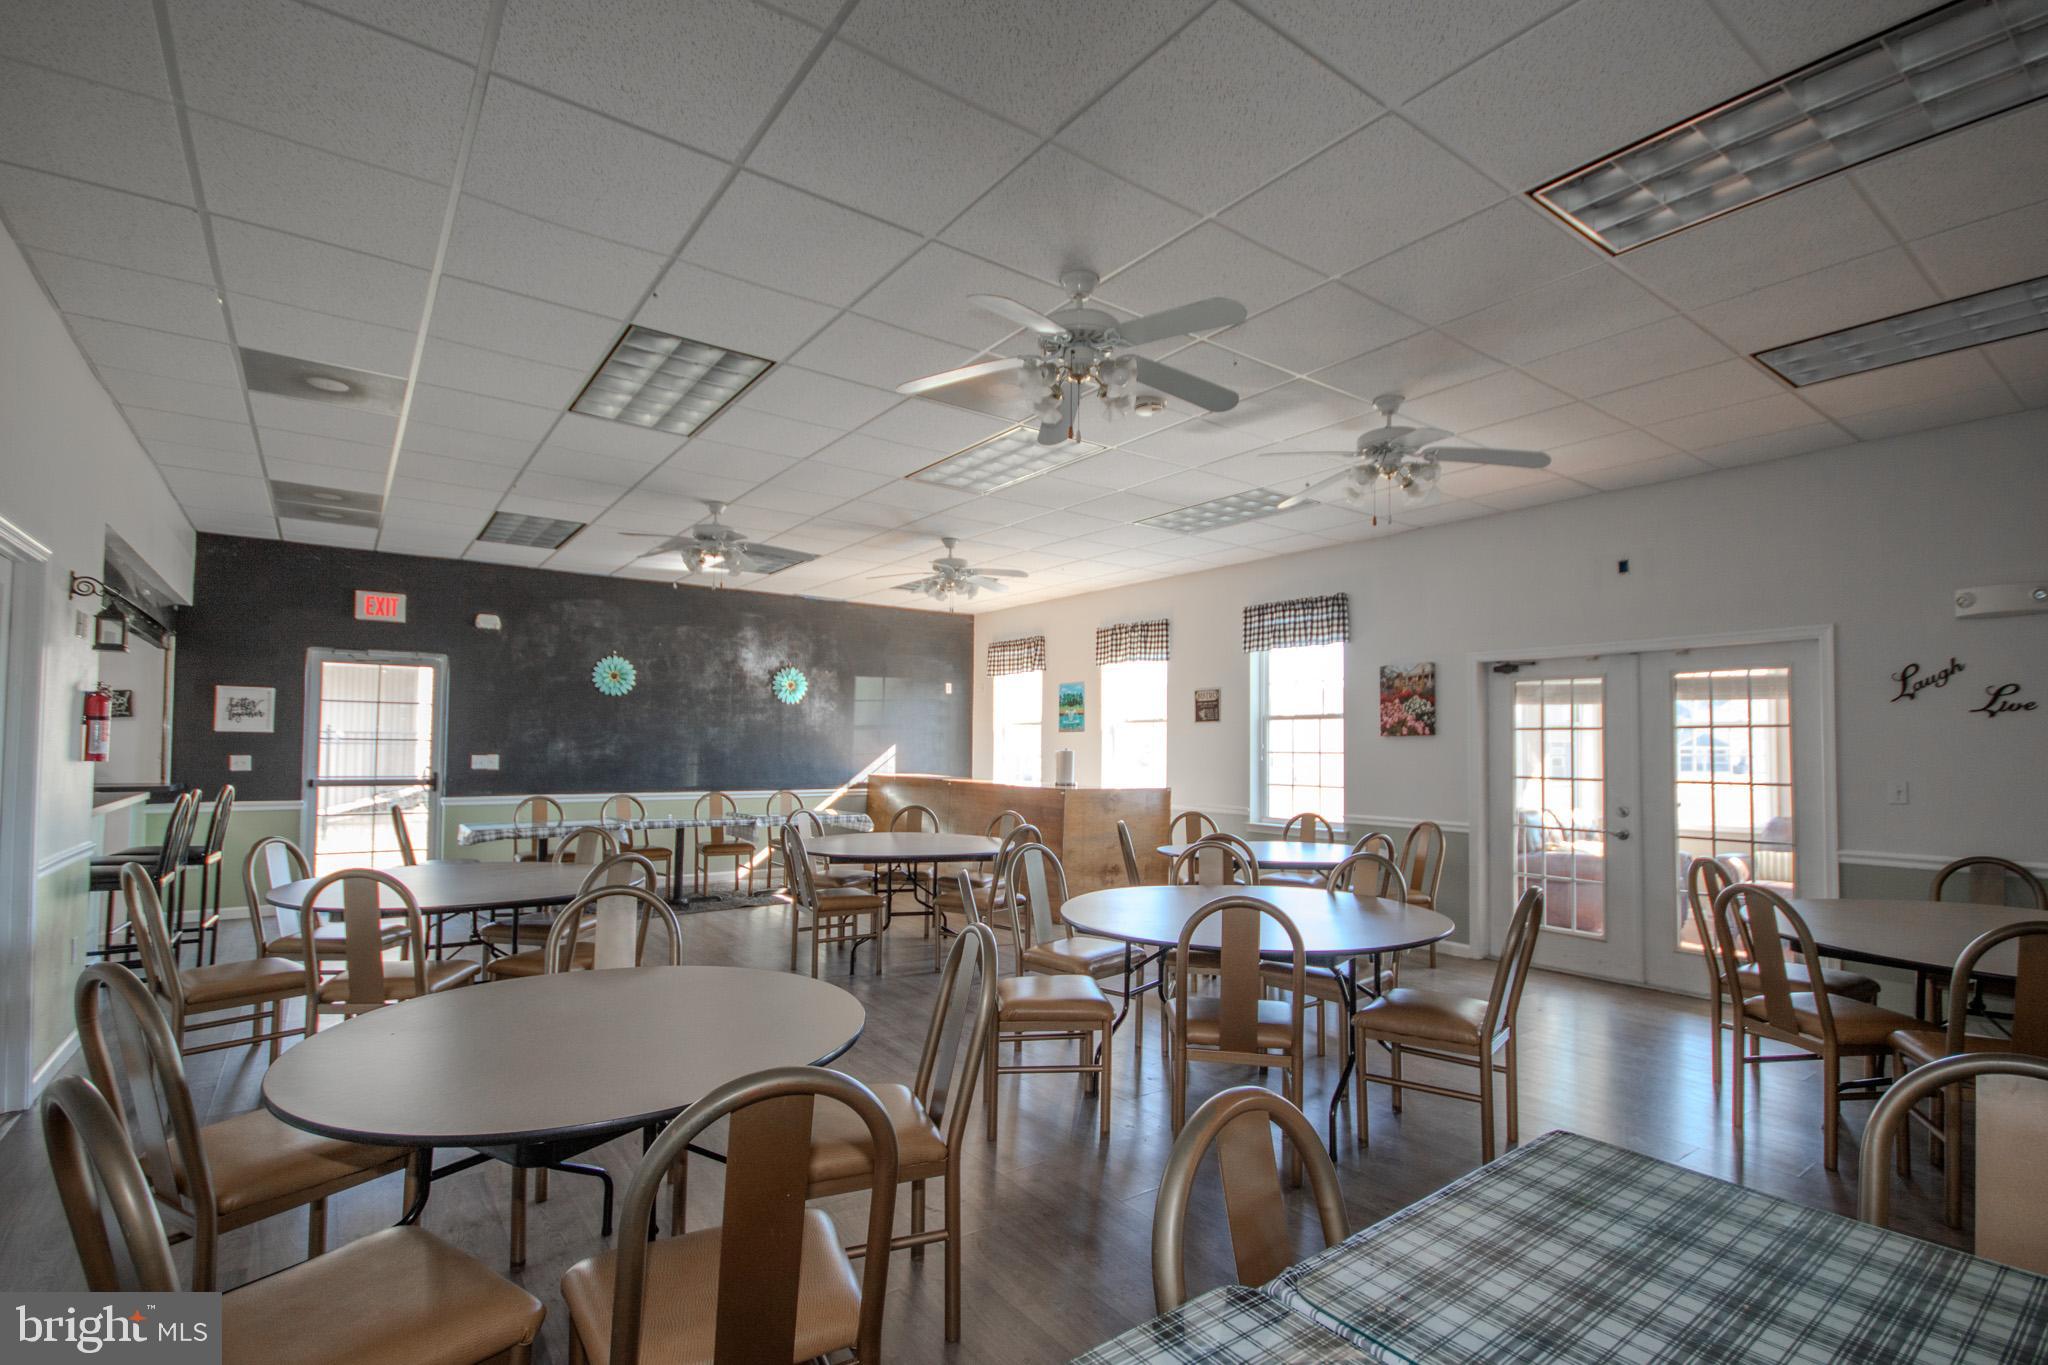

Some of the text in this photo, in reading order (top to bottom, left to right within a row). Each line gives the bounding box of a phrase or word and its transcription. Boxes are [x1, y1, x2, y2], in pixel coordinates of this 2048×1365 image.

[365, 595, 400, 617] EXIT
[1890, 657, 1966, 703] Laugh
[1969, 683, 2039, 718] Live
